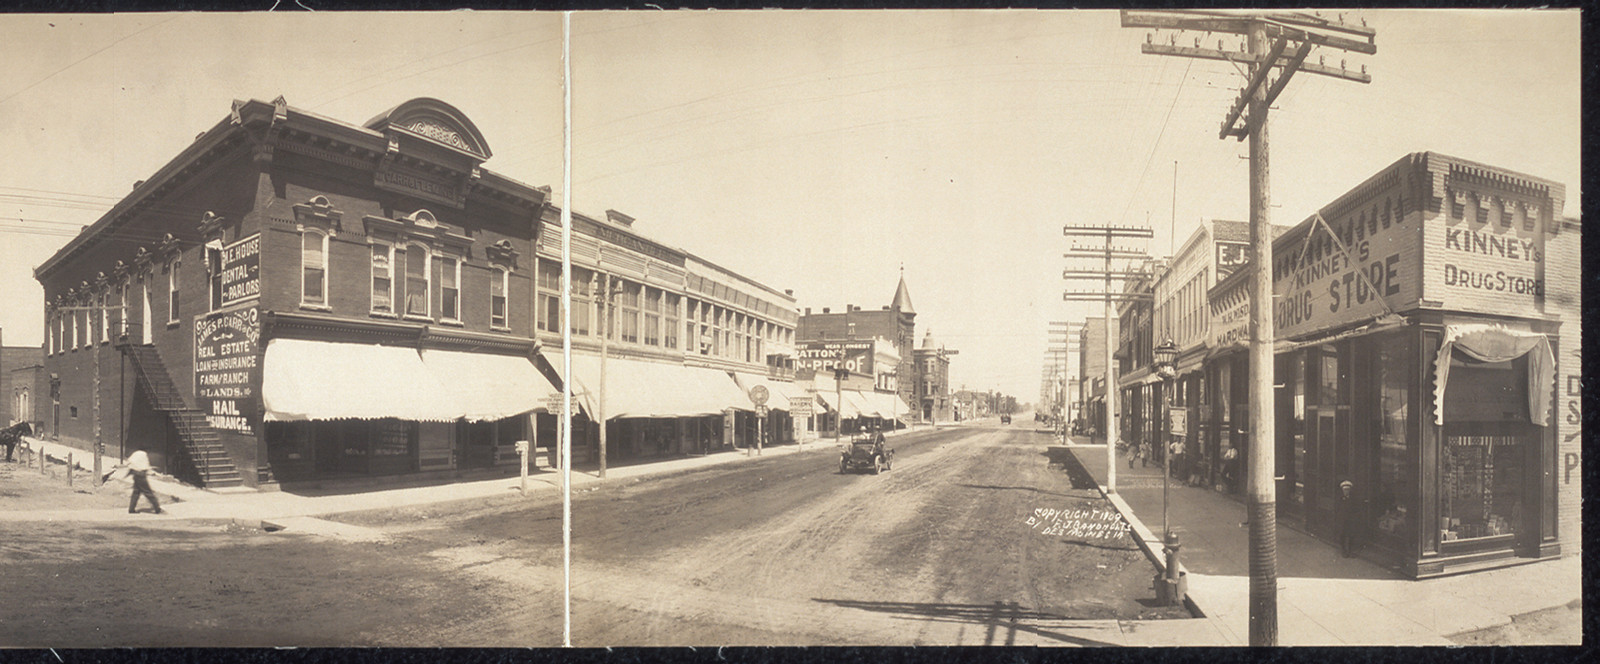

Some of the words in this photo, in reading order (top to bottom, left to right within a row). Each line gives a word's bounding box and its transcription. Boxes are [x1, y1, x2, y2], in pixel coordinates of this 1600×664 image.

[236, 239, 259, 260] HOUSE
[222, 264, 248, 284] DENTAL
[1296, 240, 1370, 290] KINNEY'S
[229, 279, 259, 299] PARLORS
[1279, 289, 1312, 329] DRUG
[1330, 253, 1399, 313] STORE
[198, 320, 216, 348] JAMES
[224, 316, 242, 331] CARR
[1217, 323, 1248, 346] HARDWA
[198, 346, 216, 358] REAL
[221, 340, 250, 355] ESTATE
[196, 361, 211, 372] LOAN
[218, 355, 256, 370] INSURANCE
[200, 374, 218, 385] FARM
[222, 372, 249, 384] RANCH
[213, 400, 240, 415] HAIL
[206, 415, 251, 430] SURANCE.
